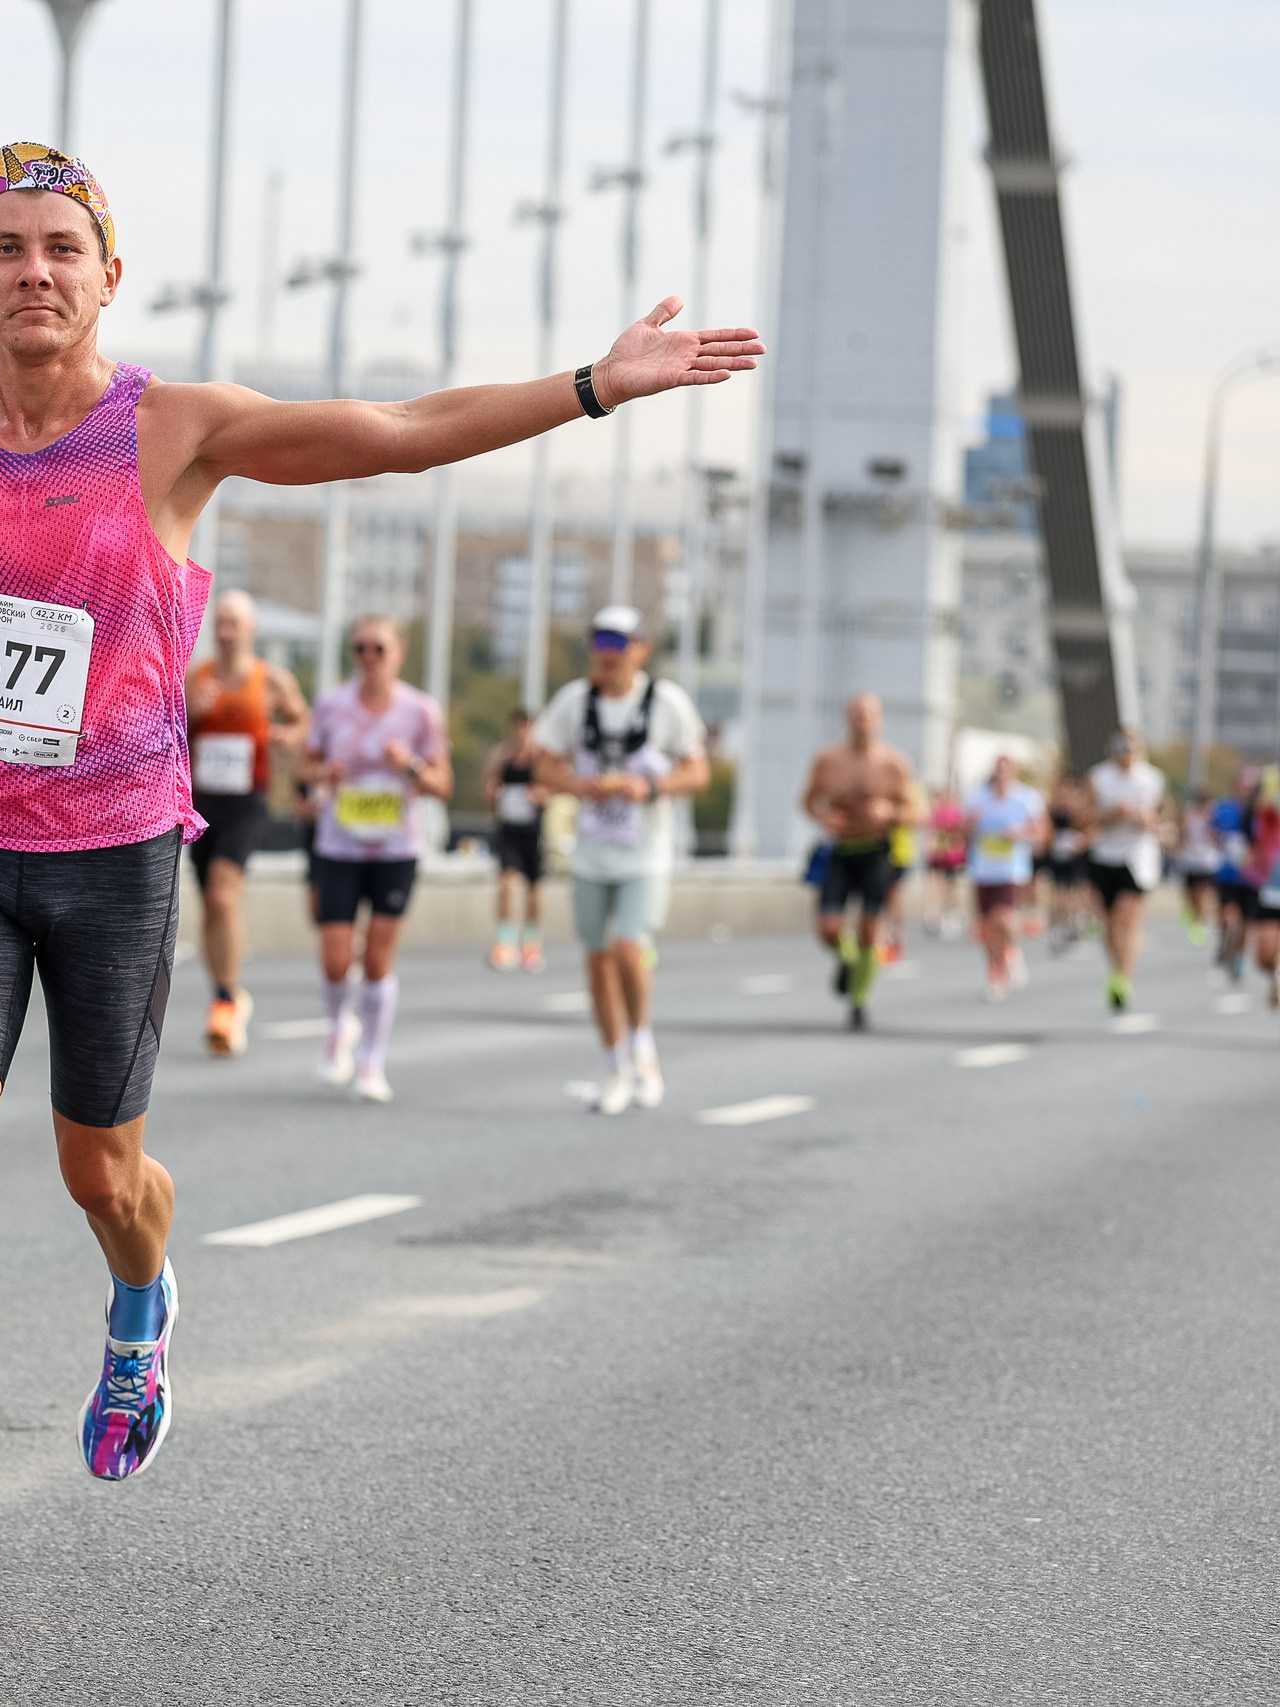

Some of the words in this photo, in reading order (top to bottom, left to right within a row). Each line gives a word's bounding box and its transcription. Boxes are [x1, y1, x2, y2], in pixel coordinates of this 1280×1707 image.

[35, 610, 56, 620] 42,2
[57, 613, 73, 622] КМ
[62, 709, 70, 719] 2
